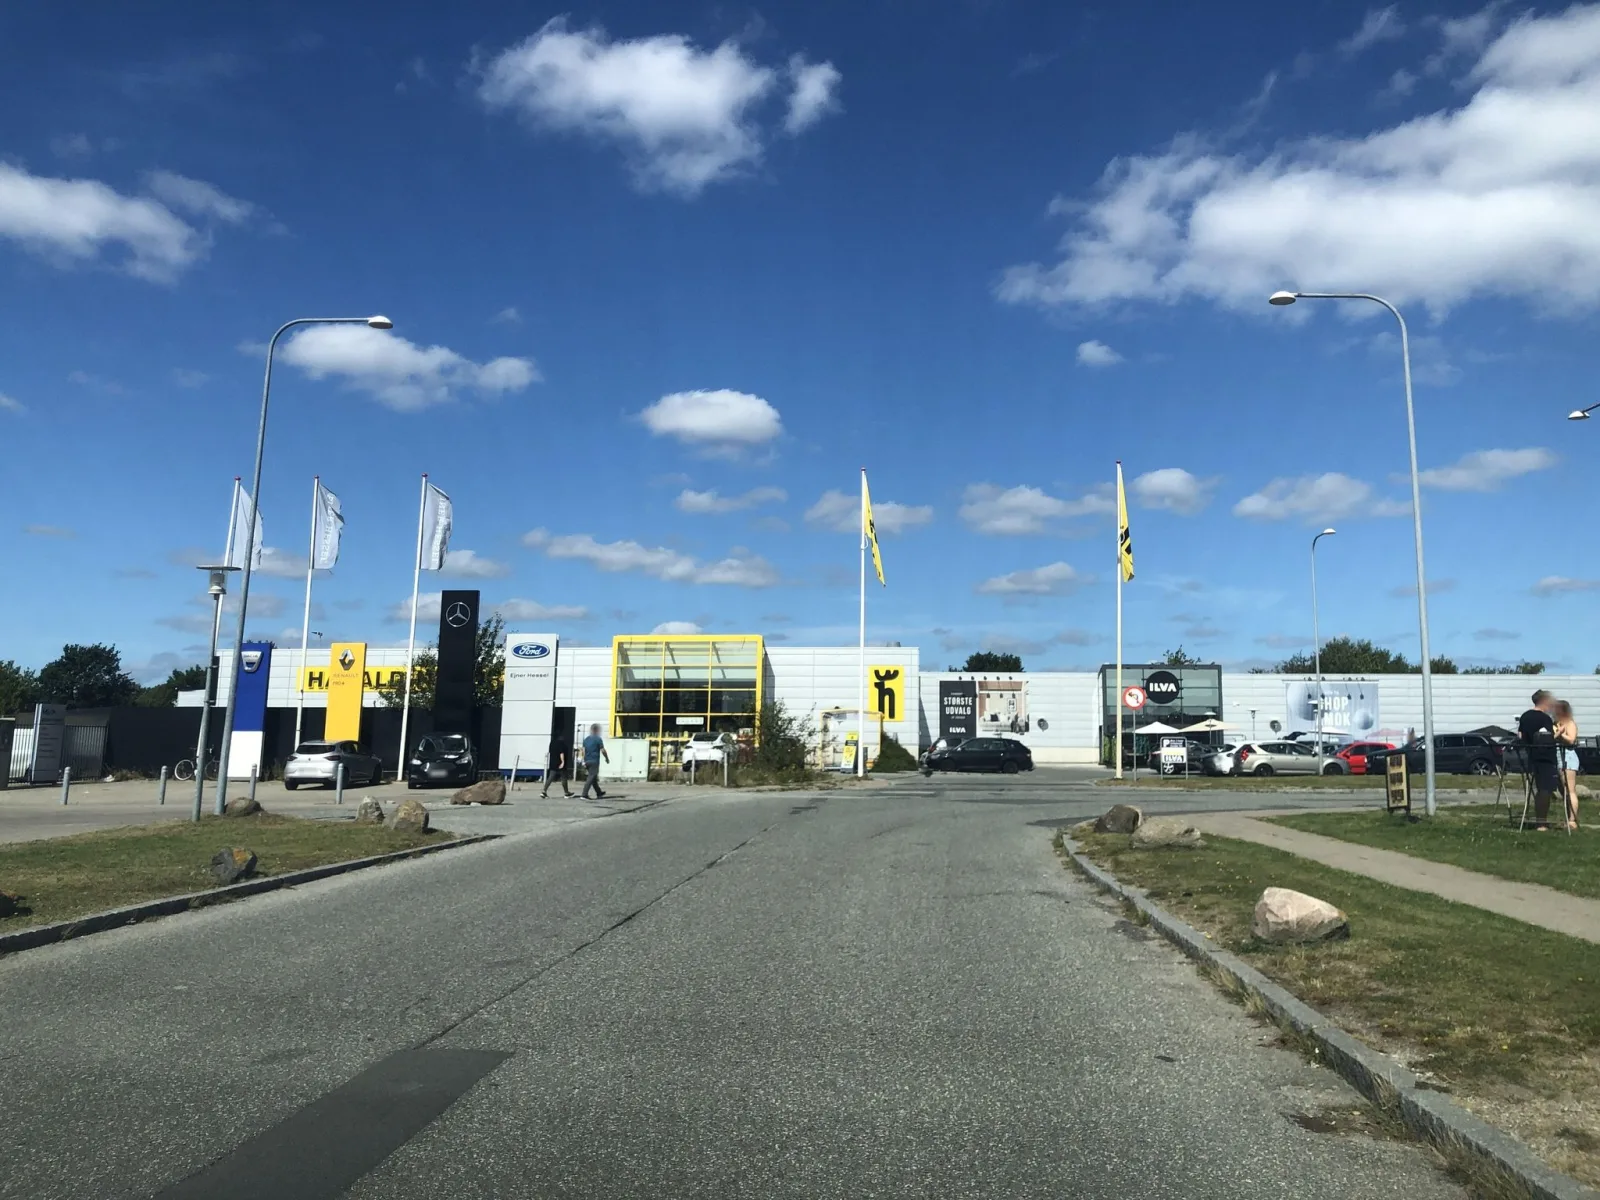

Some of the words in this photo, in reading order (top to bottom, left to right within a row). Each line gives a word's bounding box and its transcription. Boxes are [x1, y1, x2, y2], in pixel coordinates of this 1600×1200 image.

[518, 645, 542, 654] Ford
[308, 671, 404, 689] HALD
[1149, 682, 1177, 692] ILVA
[943, 697, 973, 705] STØRSTE
[945, 706, 972, 715] UDVALG
[1316, 711, 1351, 727] MOK
